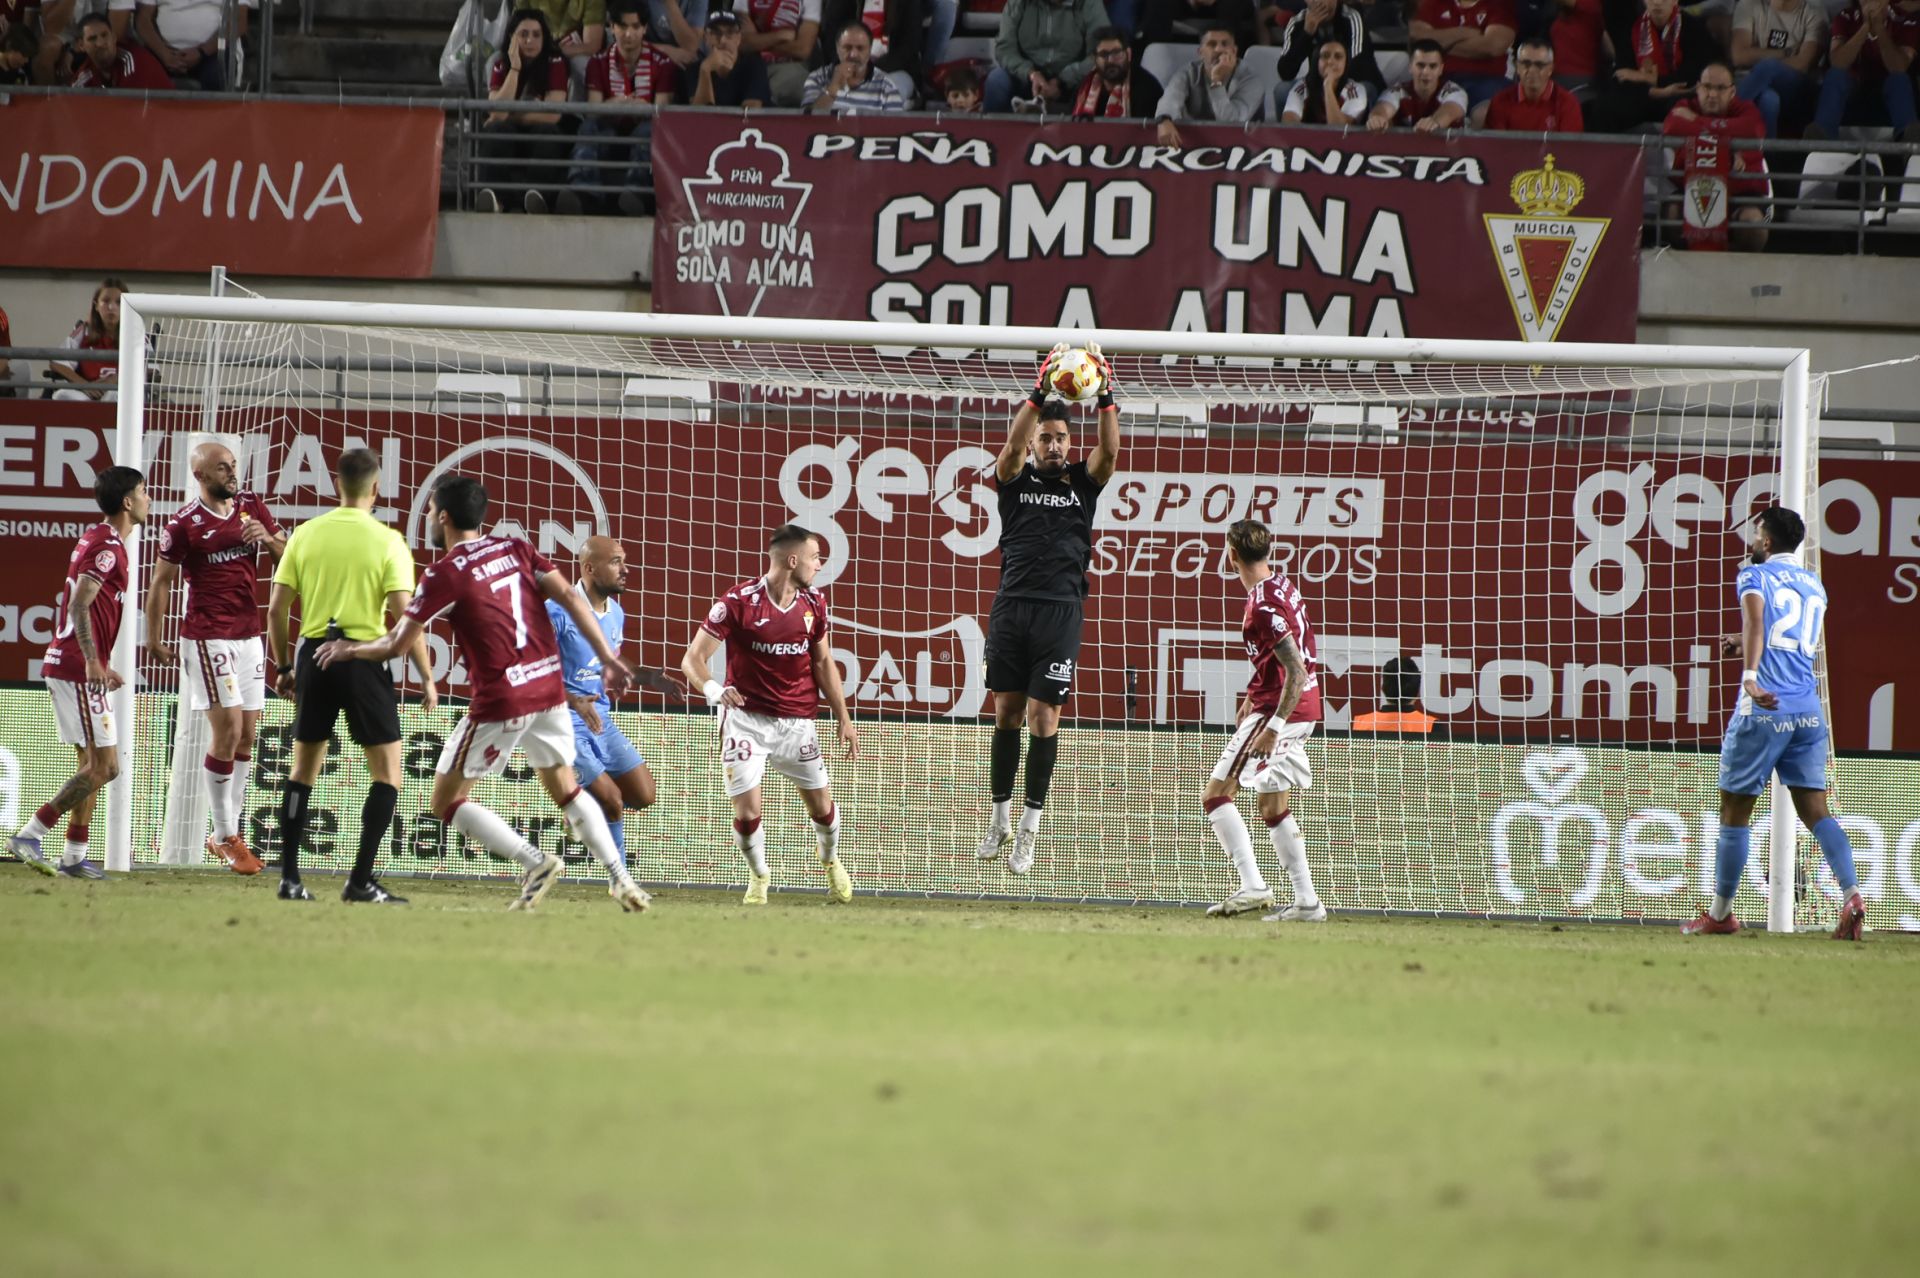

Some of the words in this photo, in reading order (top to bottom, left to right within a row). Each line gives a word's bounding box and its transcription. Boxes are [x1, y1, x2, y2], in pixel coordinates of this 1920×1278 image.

[731, 167, 763, 185] PEÑA
[808, 131, 991, 167] PEÑA
[1030, 144, 1485, 185] MURCIANISTA
[706, 191, 785, 210] MURCIANISTA
[677, 219, 746, 253] COMO
[760, 222, 815, 261] UNA
[877, 181, 1152, 274] COMO
[1213, 184, 1414, 294] UNA
[1514, 222, 1576, 236] MURCIA
[676, 256, 732, 283] SOLA
[746, 258, 814, 288] ALMA
[1502, 243, 1534, 323] CLUB
[1547, 245, 1589, 323] FUTBOL
[1111, 480, 1364, 528] SPORTS
[490, 572, 527, 649] 7
[1767, 588, 1827, 659] 20
